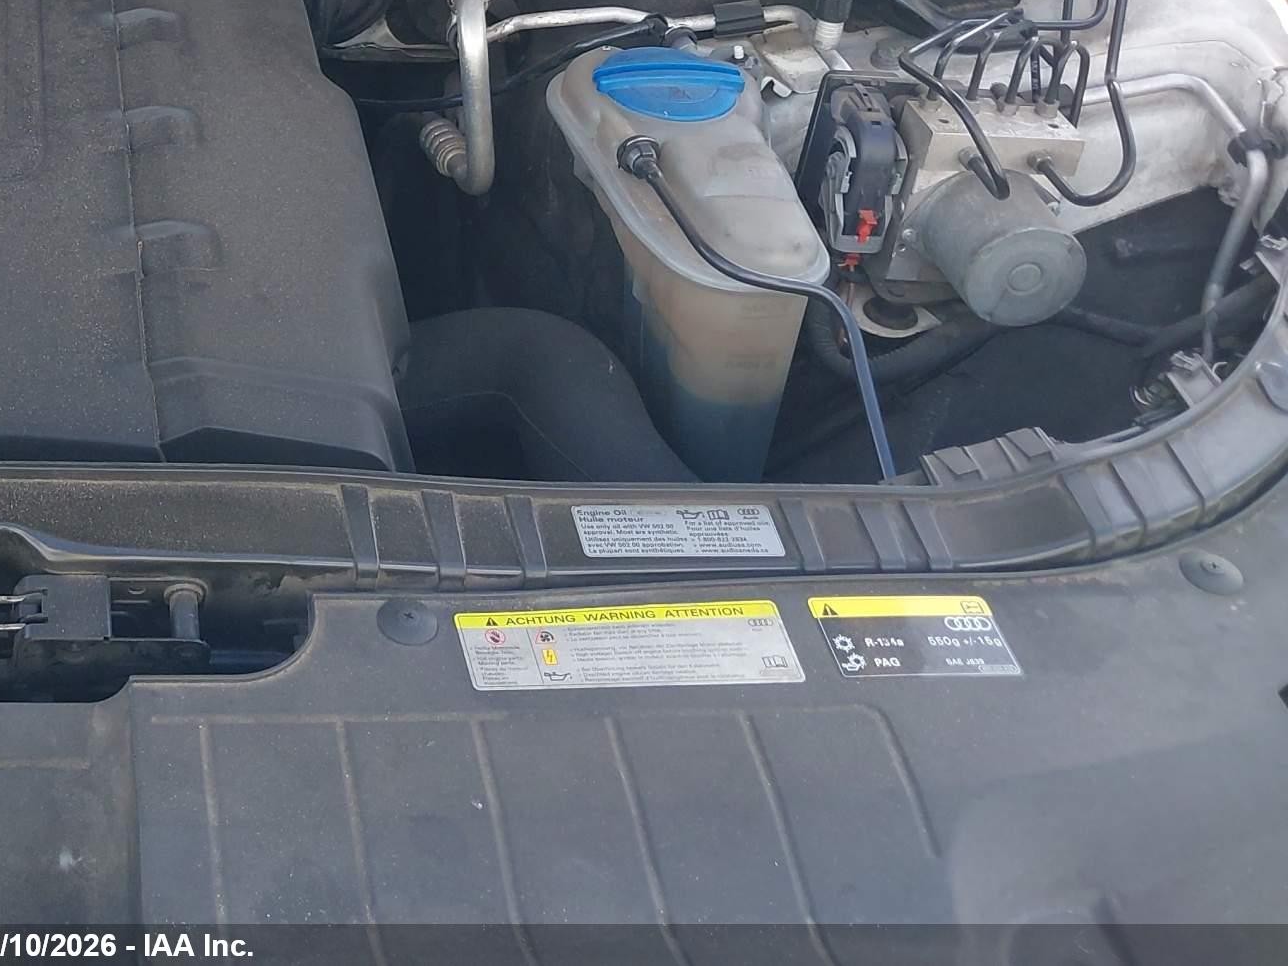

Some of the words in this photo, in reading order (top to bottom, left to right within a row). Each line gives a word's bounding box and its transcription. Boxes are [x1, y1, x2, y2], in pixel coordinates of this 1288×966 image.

[576, 509, 611, 517] Engine
[505, 615, 576, 626] ACHTUNG
[584, 610, 656, 621] WARNING
[664, 606, 744, 617] ATTENTION
[864, 637, 904, 648] R-134a
[873, 657, 902, 668] PAG
